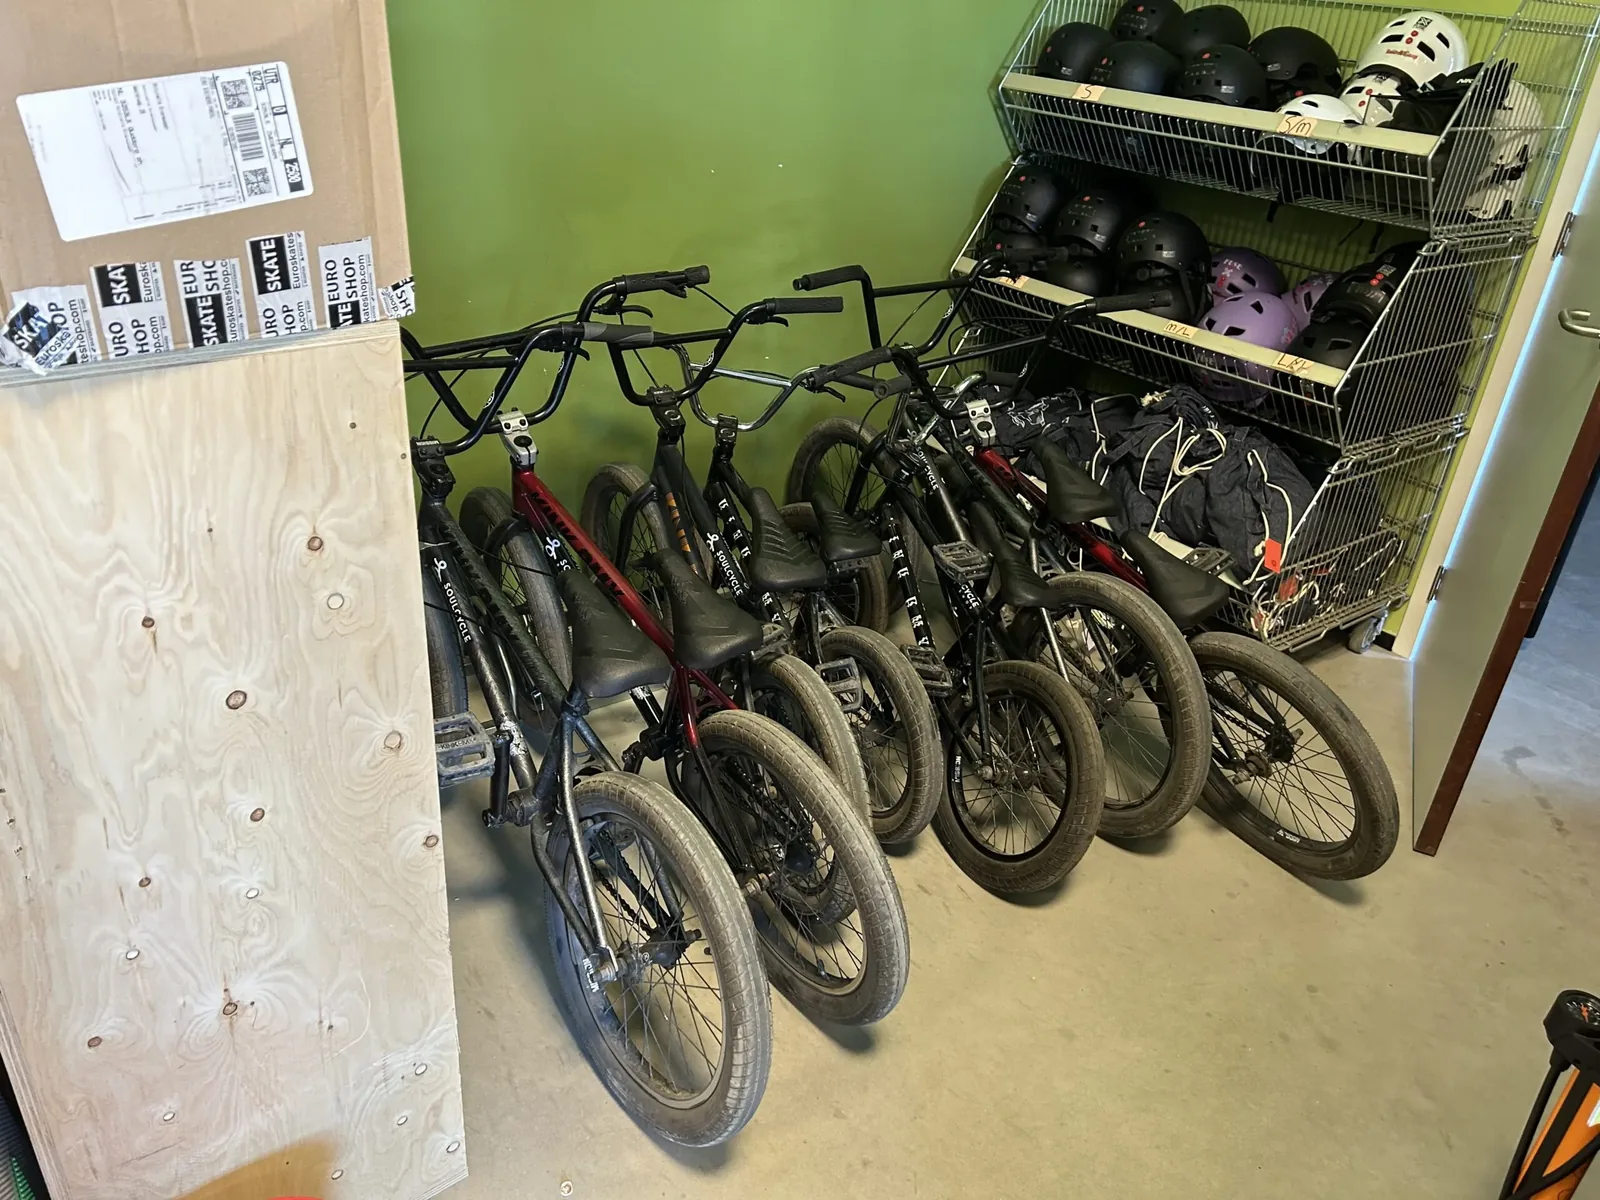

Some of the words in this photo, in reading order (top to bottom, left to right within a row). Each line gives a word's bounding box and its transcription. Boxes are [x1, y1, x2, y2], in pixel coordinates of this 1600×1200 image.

[180, 261, 199, 295] EUR
[260, 238, 282, 292] SKATE
[324, 259, 341, 302] EURO
[342, 256, 359, 299] SHOP
[358, 254, 371, 323] kateshop.com
[196, 296, 220, 346] SKATE
[220, 259, 239, 343] uroskateshop.c
[108, 321, 130, 358] URO
[131, 318, 150, 354] HOP
[716, 550, 744, 597] SOULCYCLE
[443, 581, 472, 643] SOULCYCLE
